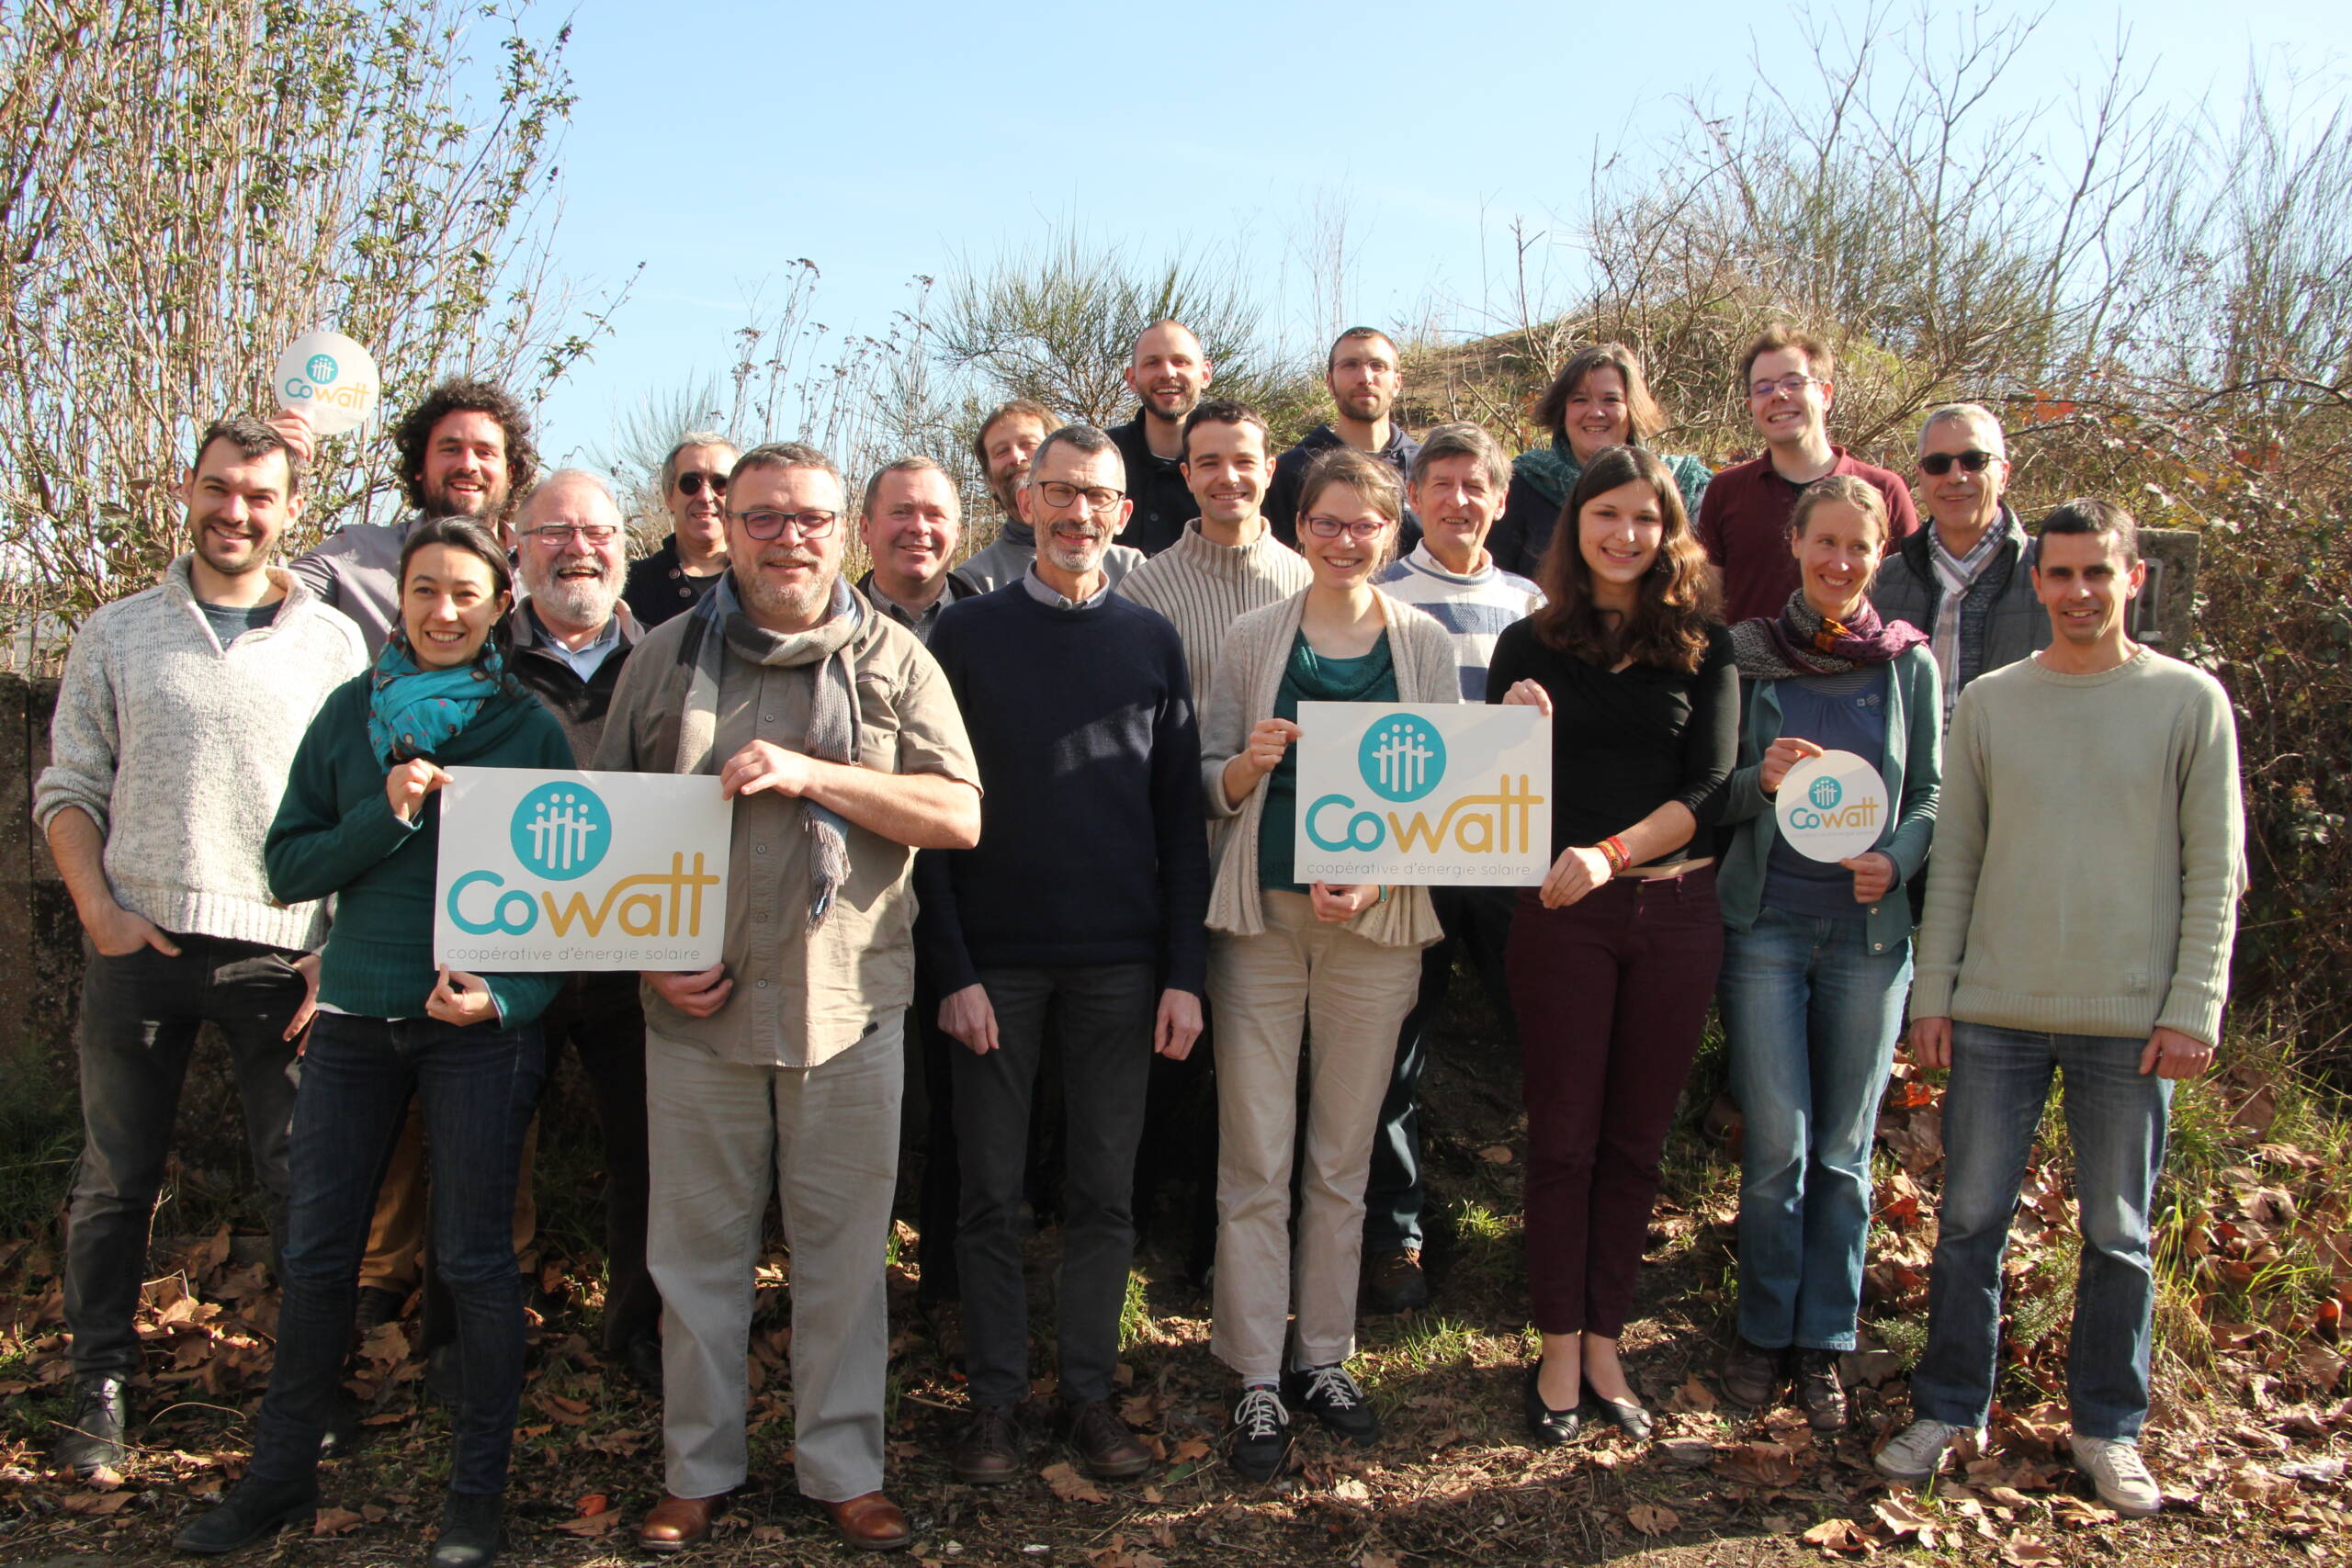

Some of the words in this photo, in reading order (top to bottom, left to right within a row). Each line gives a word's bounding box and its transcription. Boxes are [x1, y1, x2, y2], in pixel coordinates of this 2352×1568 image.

[285, 378, 370, 410] Cowatt
[1306, 774, 1544, 853] Cowatt
[1790, 796, 1880, 829] Cowatt
[1306, 862, 1398, 877] coopérative
[1404, 862, 1476, 878] d'énergie
[1481, 863, 1531, 876] solaire
[447, 852, 720, 937] Cowatt
[447, 947, 552, 962] coopérative
[559, 946, 639, 963] d'énergie
[645, 947, 700, 961] solaire
